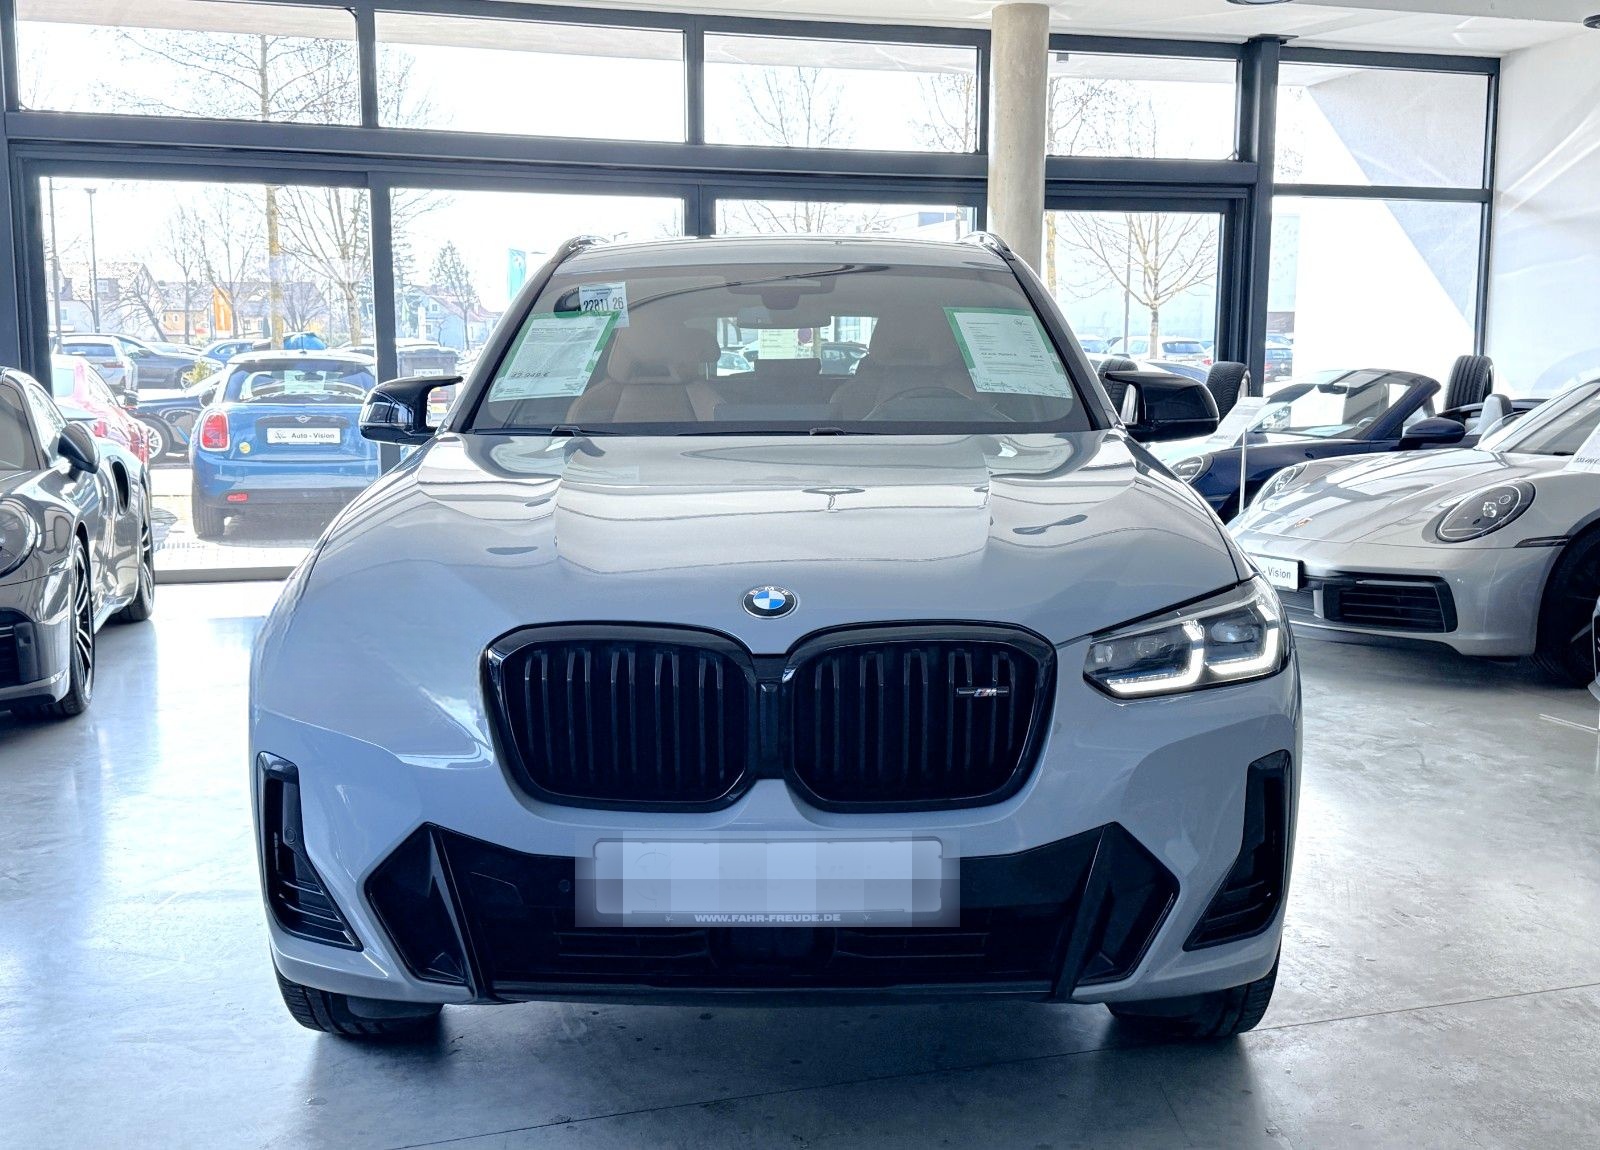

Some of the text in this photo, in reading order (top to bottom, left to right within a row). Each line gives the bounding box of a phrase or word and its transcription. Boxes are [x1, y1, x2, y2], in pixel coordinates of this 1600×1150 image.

[612, 296, 624, 310] 26
[1267, 566, 1291, 579] Vision
[748, 586, 791, 596] BMW
[694, 913, 841, 923] WWW.FAHR-FREUDE.DE
